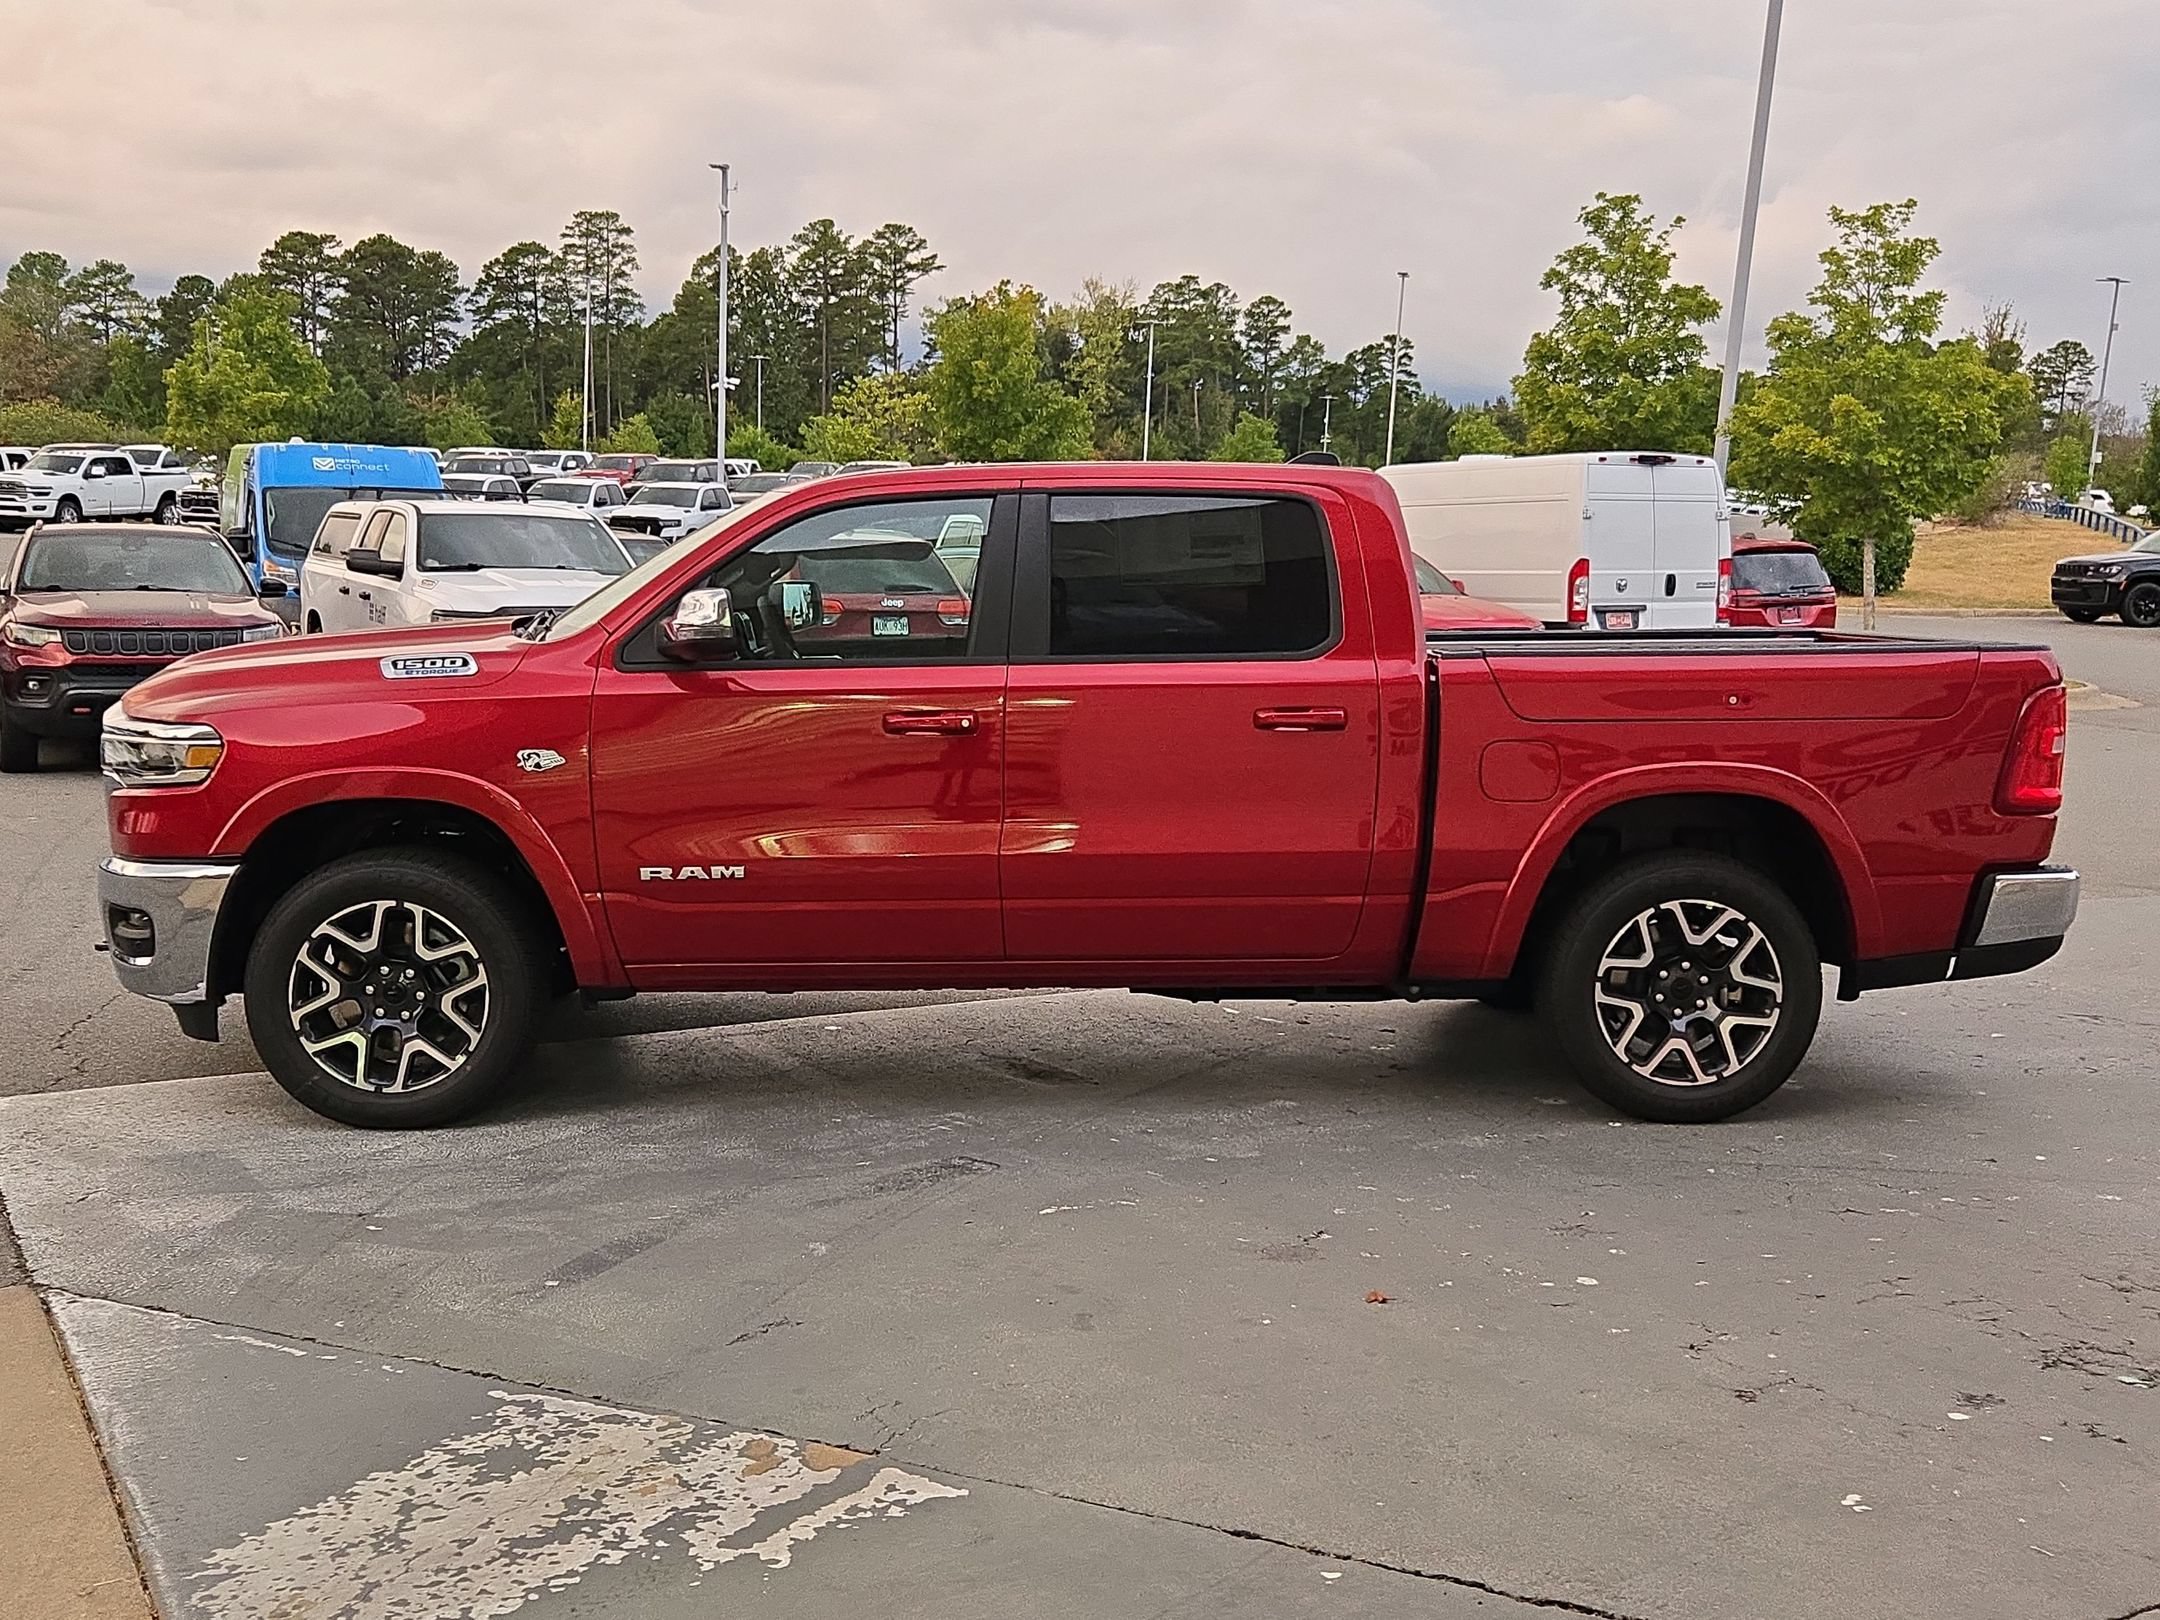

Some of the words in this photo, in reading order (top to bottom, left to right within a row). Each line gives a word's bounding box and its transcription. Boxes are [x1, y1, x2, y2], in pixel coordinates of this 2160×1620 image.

[335, 463, 390, 471] connect
[881, 597, 904, 608] Jeep
[395, 658, 463, 669] 1500
[640, 866, 745, 880] RAM
